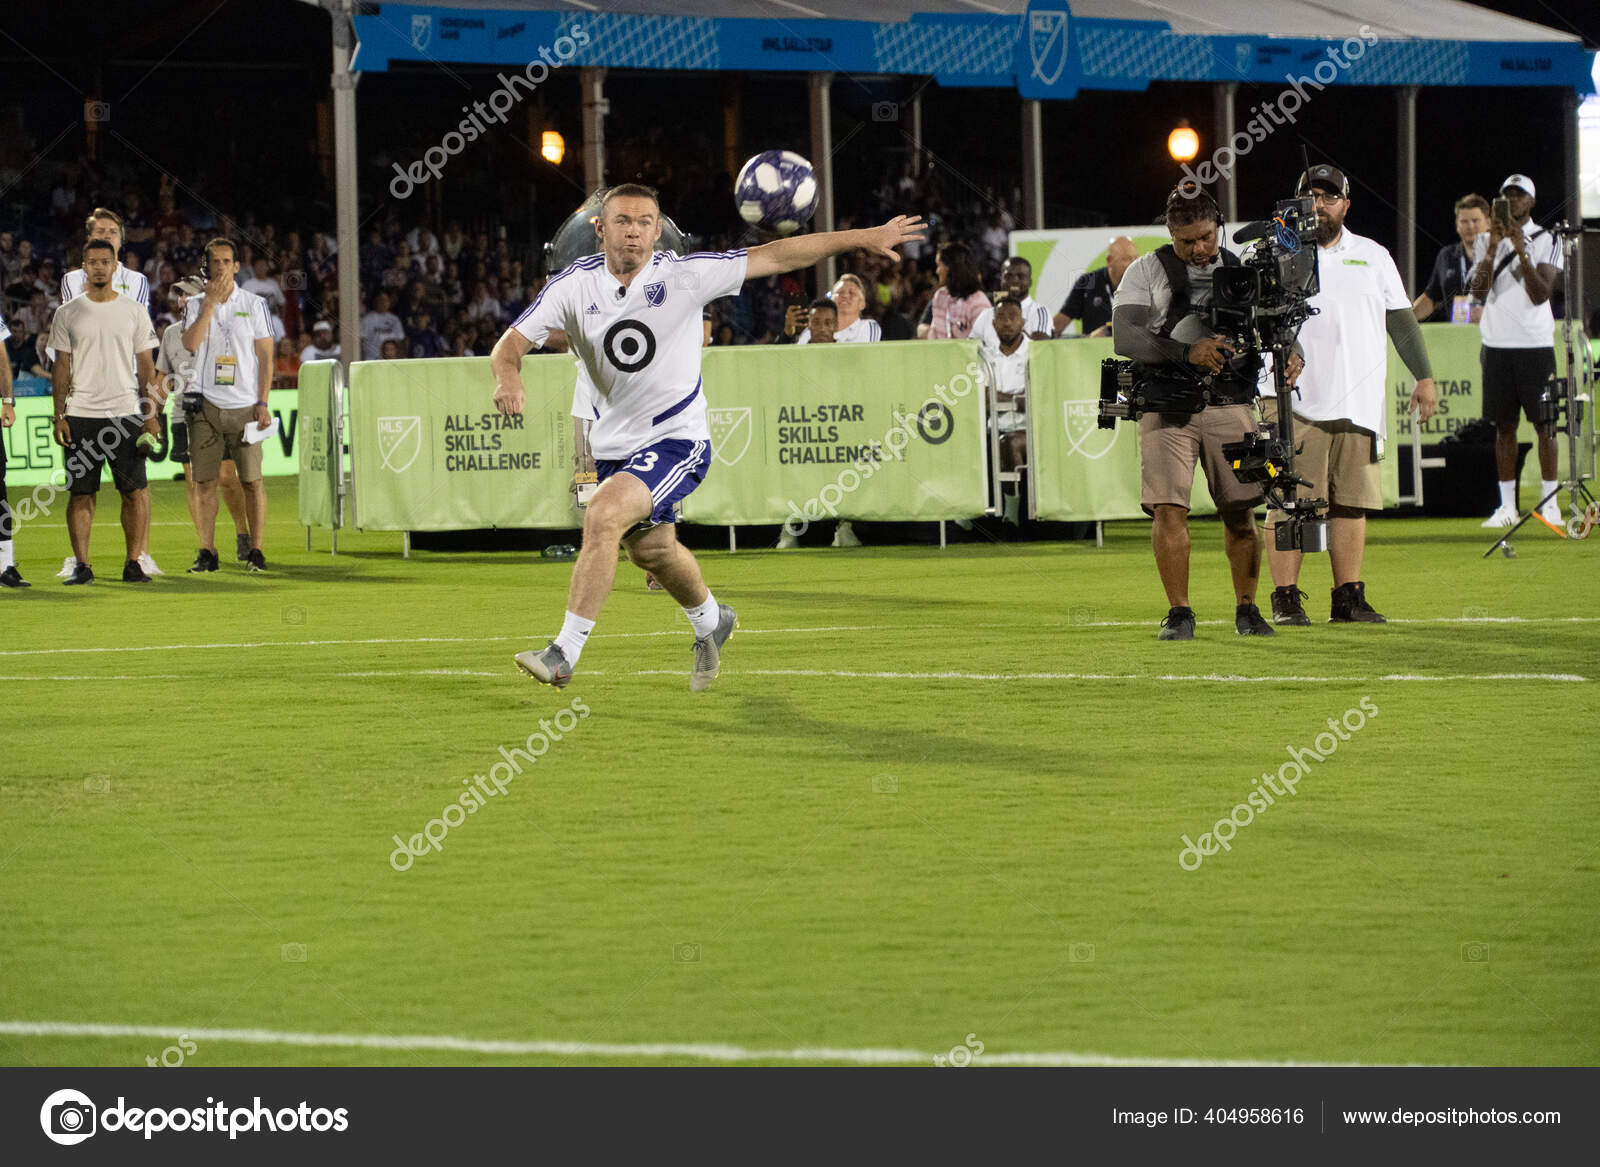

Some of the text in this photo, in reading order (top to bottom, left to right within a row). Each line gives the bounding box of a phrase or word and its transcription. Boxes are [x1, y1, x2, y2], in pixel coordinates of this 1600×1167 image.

[711, 412, 733, 426] MLS
[777, 404, 865, 424] ALL-STAR
[1069, 405, 1097, 417] MLS
[380, 422, 403, 434] MLS
[444, 414, 524, 432] ALL-STAR
[445, 433, 502, 452] SKILLS
[778, 425, 839, 444] SKILLS
[446, 452, 541, 472] CHALLENGE
[779, 445, 883, 465] CHALLENGE
